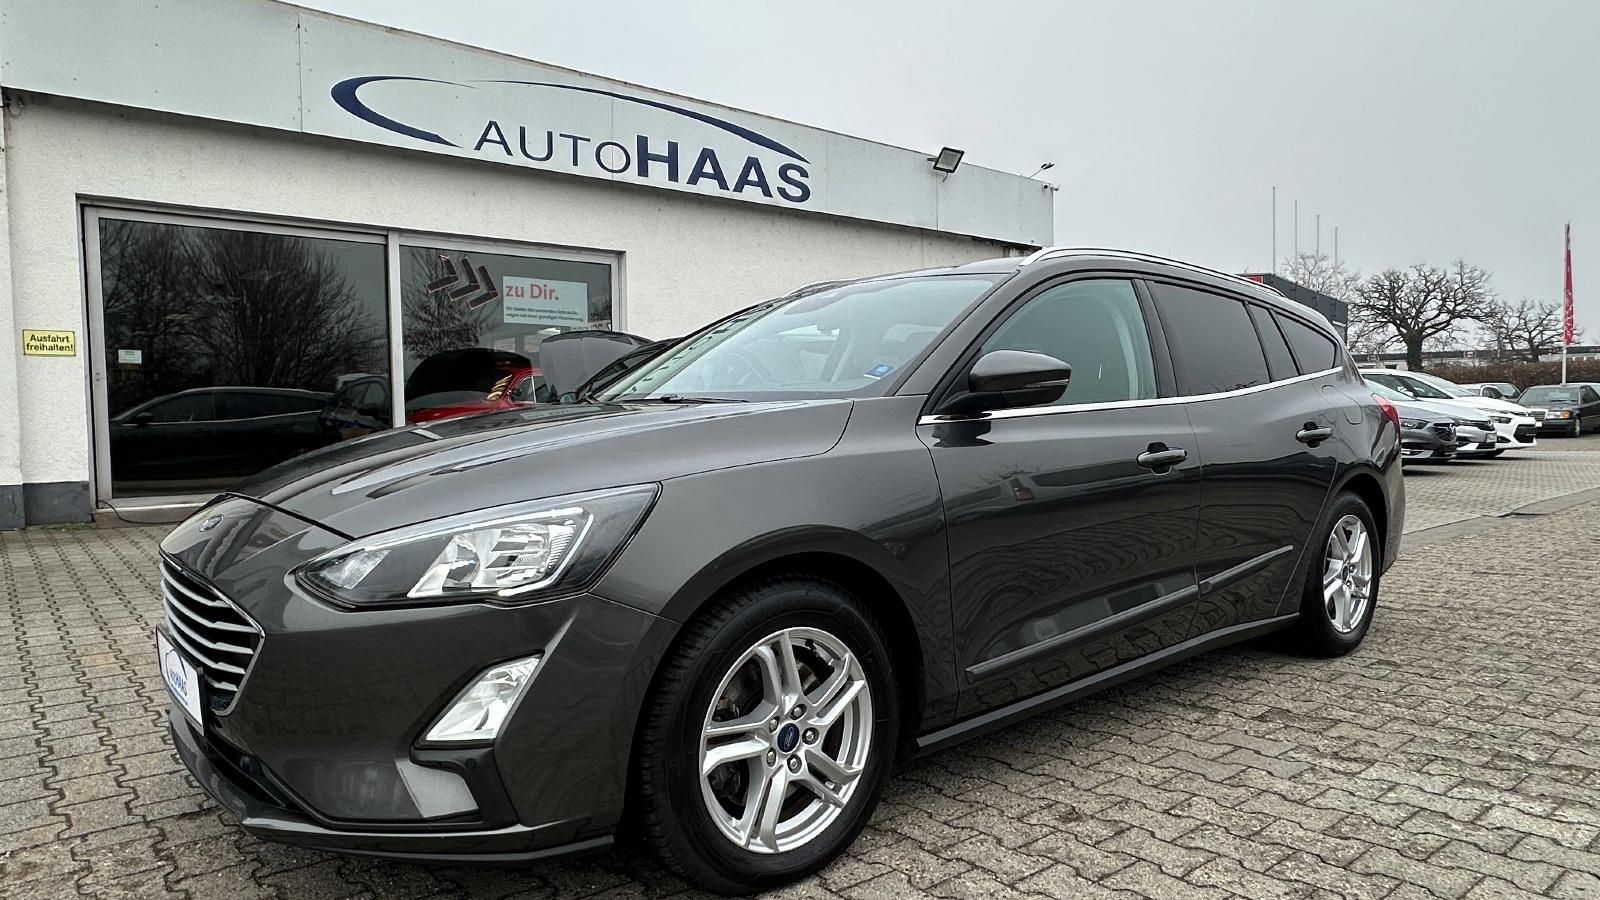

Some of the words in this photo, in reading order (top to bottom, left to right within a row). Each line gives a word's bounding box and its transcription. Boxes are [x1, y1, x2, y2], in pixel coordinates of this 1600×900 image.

[505, 285, 525, 298] zu
[530, 283, 559, 301] Dir.
[30, 334, 70, 343] Ausfahrt
[26, 343, 74, 352] freihalten!
